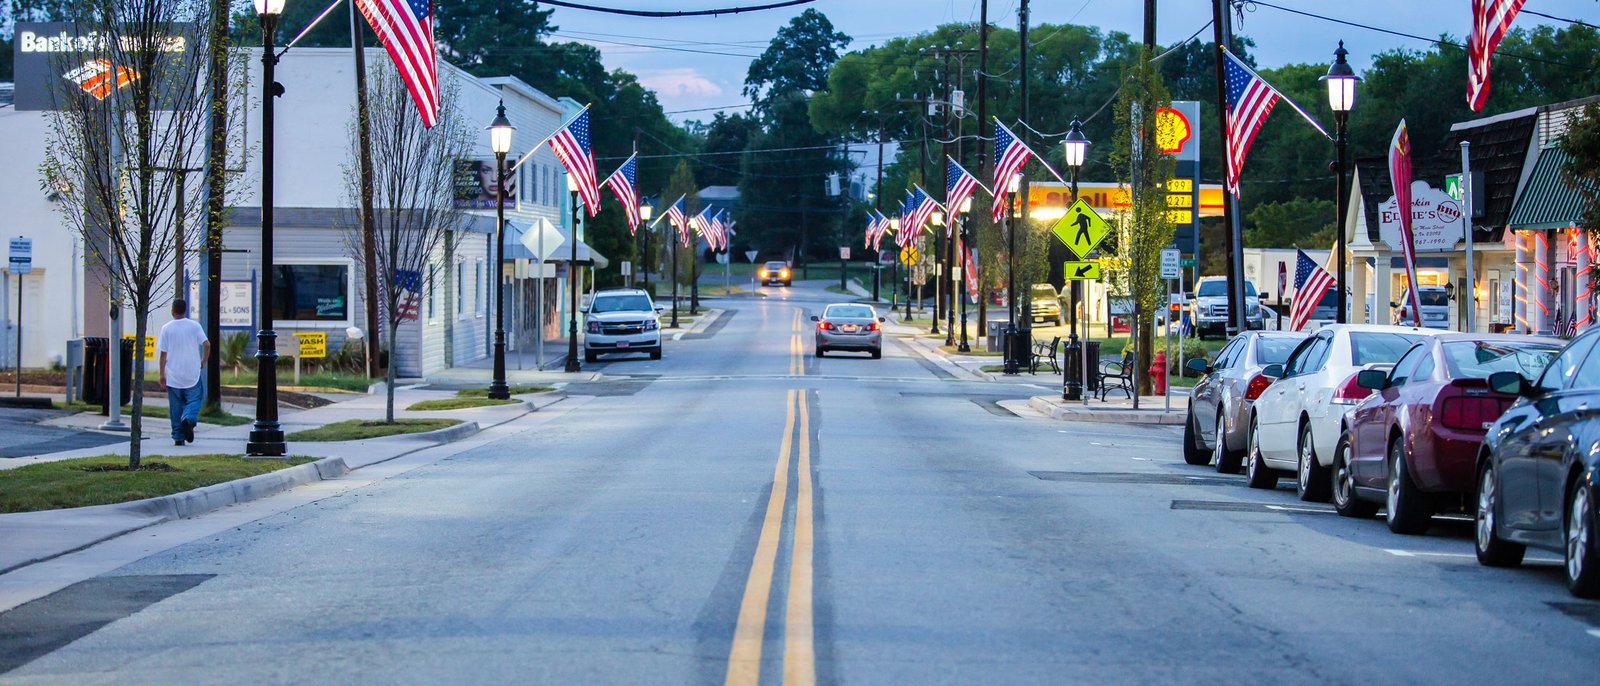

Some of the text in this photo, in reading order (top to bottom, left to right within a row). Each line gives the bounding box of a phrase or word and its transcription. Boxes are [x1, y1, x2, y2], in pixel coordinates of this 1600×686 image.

[20, 31, 73, 52] Bank
[97, 31, 186, 52] Ameica
[1046, 192, 1107, 208] Shell
[1381, 210, 1436, 223] EDIE'S
[233, 306, 250, 314] SONS
